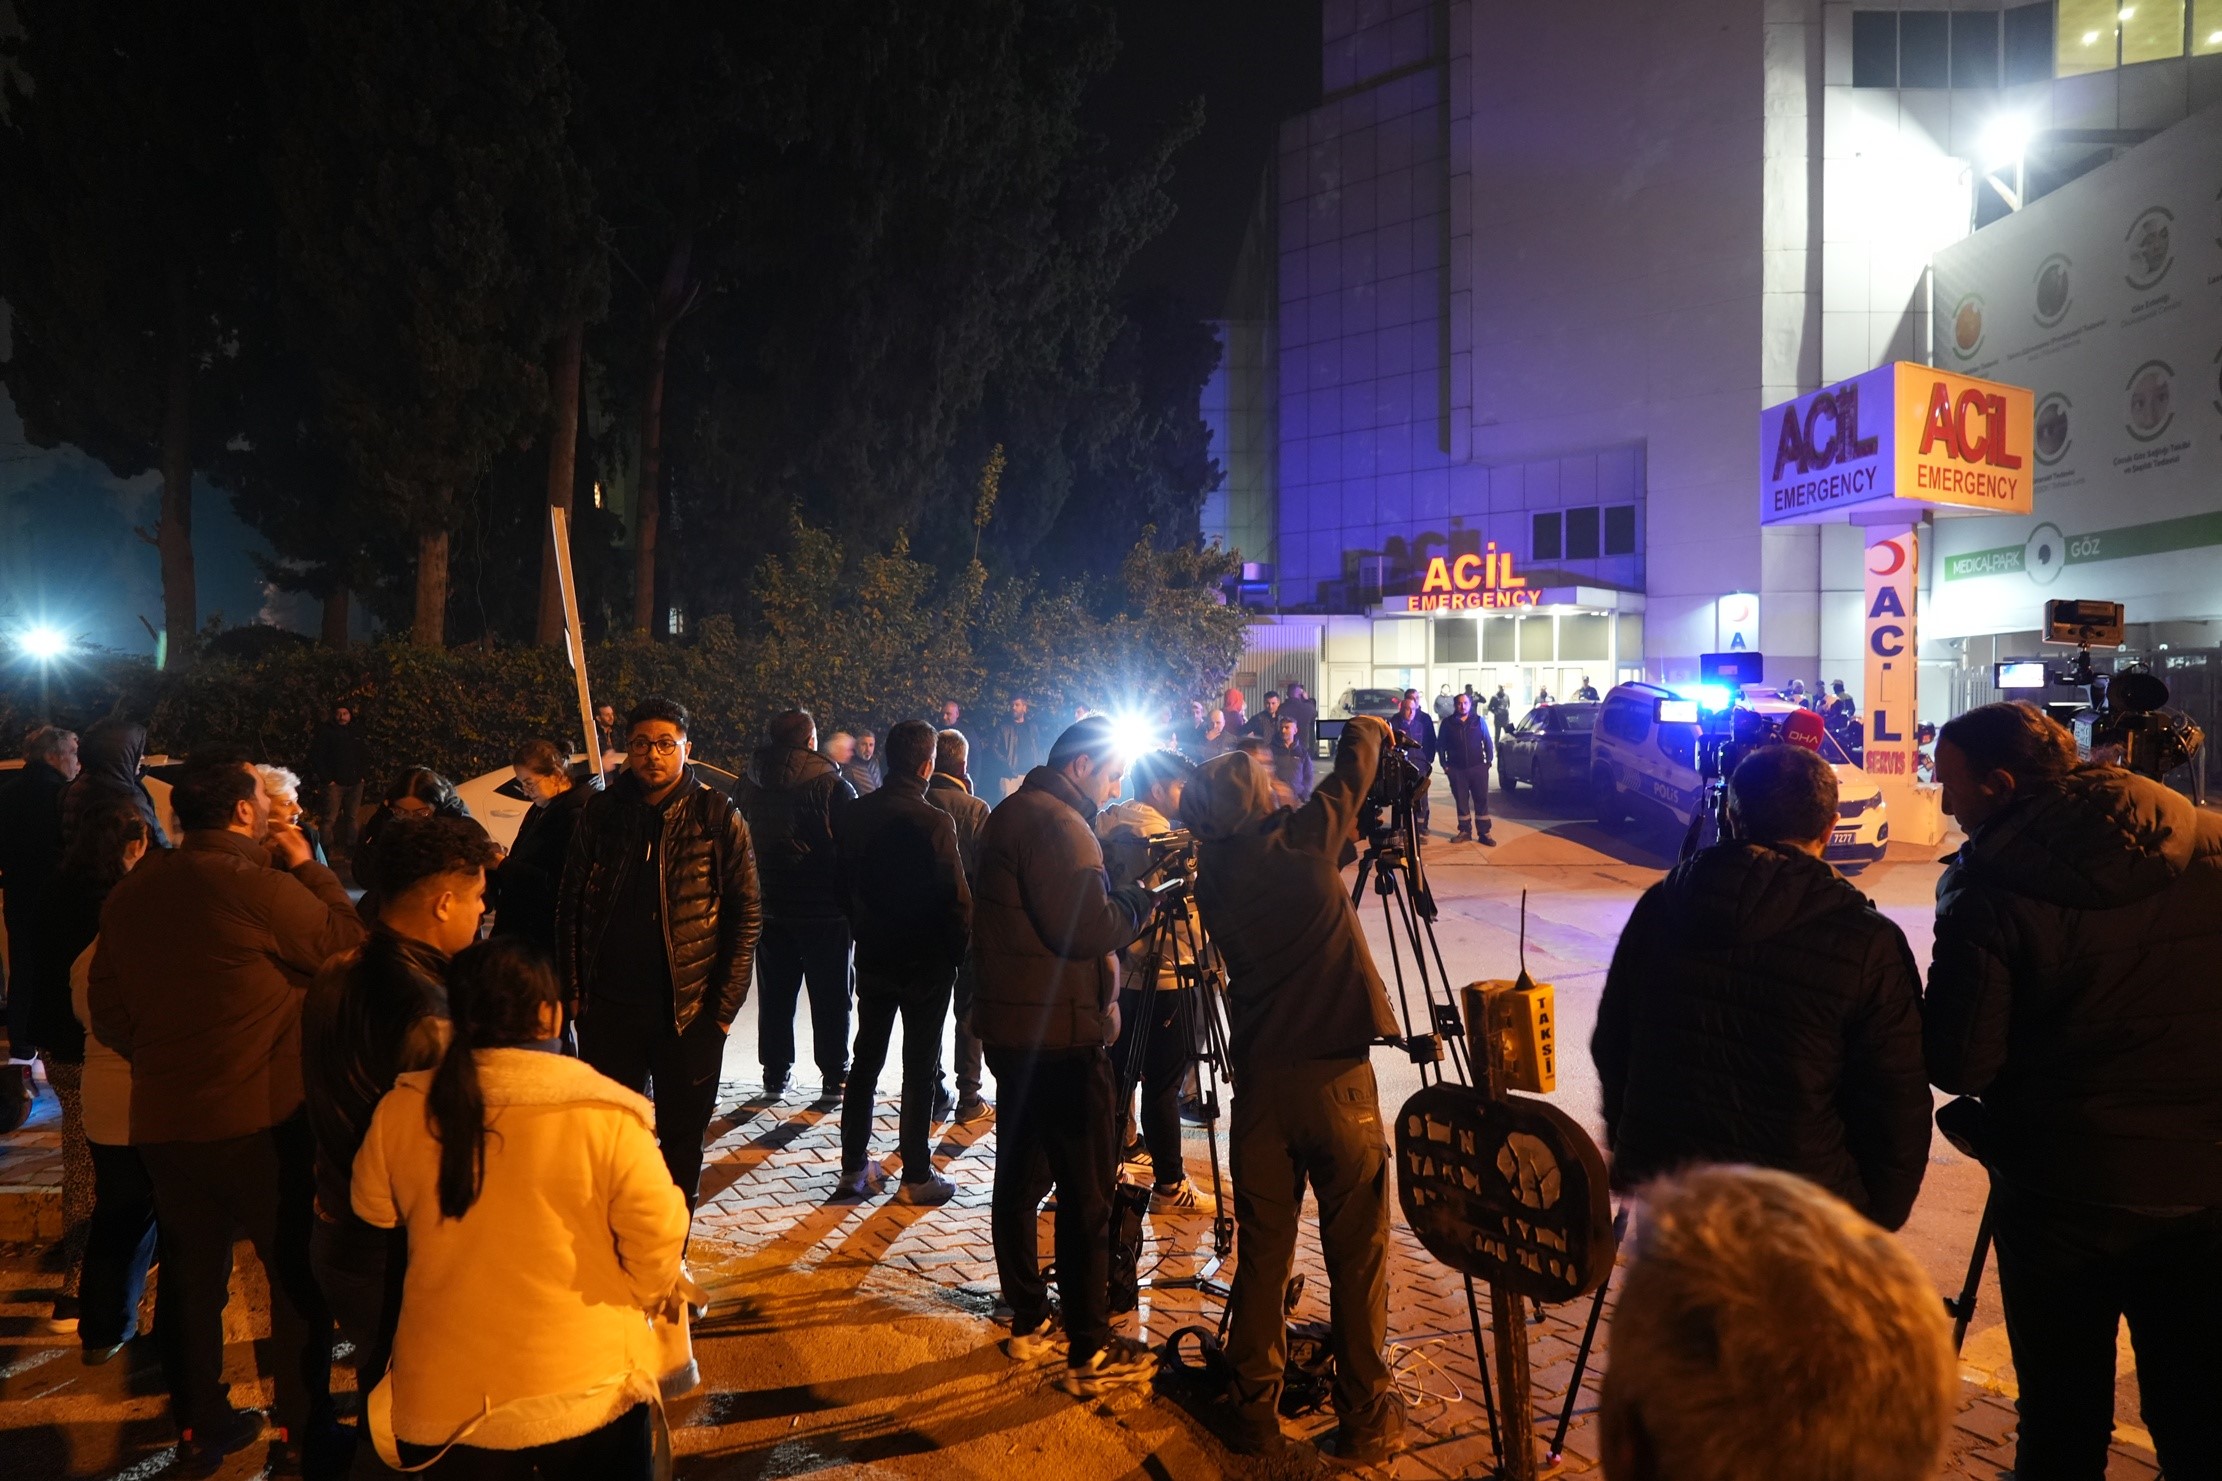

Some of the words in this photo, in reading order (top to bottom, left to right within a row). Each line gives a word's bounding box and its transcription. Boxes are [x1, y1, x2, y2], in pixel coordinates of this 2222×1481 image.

[1918, 382, 2022, 470] ACİL
[1775, 465, 1877, 511] EMERGENCY
[1918, 464, 2018, 500] EMERGENCY
[2071, 536, 2101, 558] GÖZ
[1422, 541, 1526, 592] ACİL
[1408, 589, 1542, 612] EMERGENCY
[1788, 730, 1819, 744] DHA
[1834, 833, 1853, 843] 7277
[1537, 997, 1552, 1074] TAKSİ
